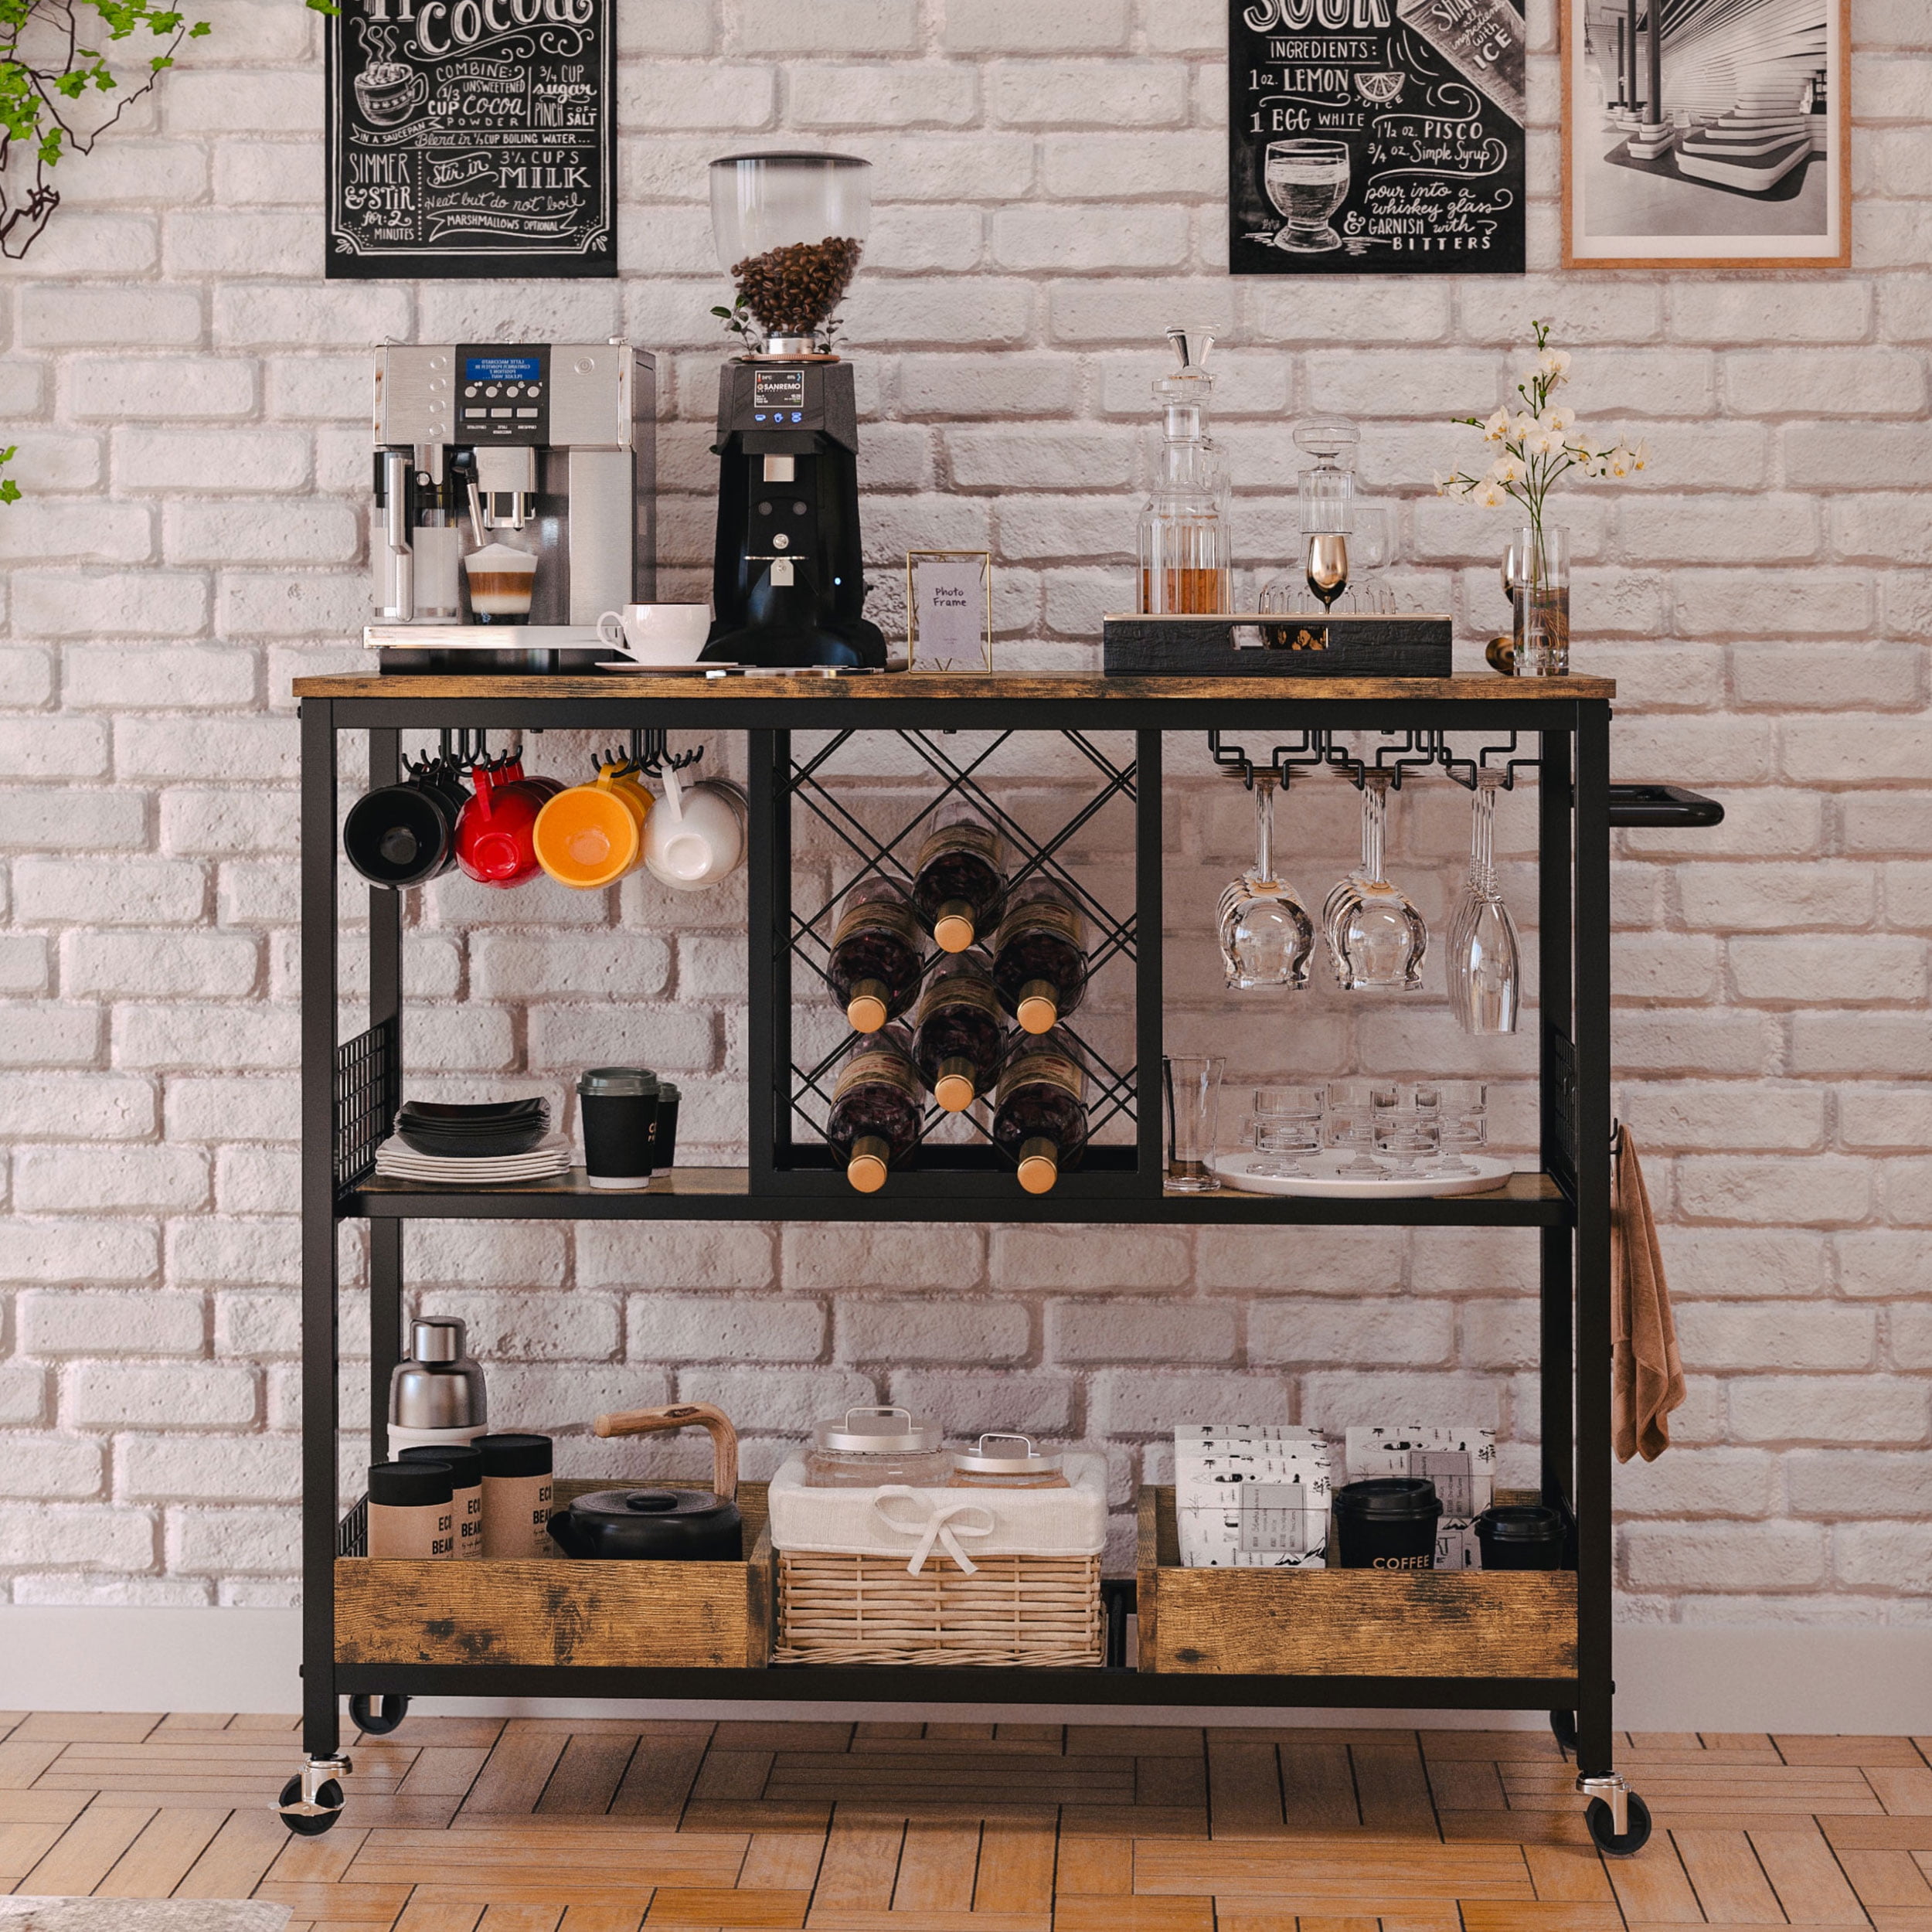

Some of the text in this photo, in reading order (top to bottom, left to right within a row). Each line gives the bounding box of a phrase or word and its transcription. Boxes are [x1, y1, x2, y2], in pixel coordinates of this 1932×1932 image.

[1472, 22, 1499, 46] with
[1270, 41, 1377, 59] INGREDIENTS:
[1473, 29, 1512, 70] ICE
[436, 62, 513, 82] COMBINE:
[561, 65, 584, 83] CUP
[1249, 69, 1260, 90] 1
[1283, 68, 1350, 93] LEMON
[463, 79, 526, 93] UNSWEETENED
[532, 83, 597, 104] sugar
[428, 94, 526, 115] CUP Cocoa
[1354, 94, 1403, 110] JUICE
[447, 117, 519, 127] POWDER
[535, 102, 563, 127] PINCH
[566, 113, 597, 126] SALT
[1250, 108, 1365, 133] 1 EGG WHITE
[360, 121, 426, 144] IN A SAUCEPAN
[415, 134, 456, 147] Blend
[457, 133, 471, 145] in
[484, 134, 500, 145] CUP
[503, 134, 539, 144] BOILING
[1424, 121, 1483, 140] PISCO
[531, 151, 579, 164] CUPS
[1409, 140, 1453, 165] Simple
[1454, 140, 1490, 169] Syrup
[349, 152, 410, 184] SIMMER
[433, 158, 490, 185] Stir in
[498, 166, 592, 189] MILK
[345, 185, 368, 209] &
[424, 192, 586, 212] Heat but do not boil
[1364, 182, 1477, 204] pour into a
[388, 210, 413, 226] 2
[1372, 198, 1493, 222] whiskey glass
[447, 214, 560, 231] MARSHMALLOWS OPTIONAL
[1343, 210, 1476, 235] & GARNISH with
[374, 228, 414, 241] MINUTES
[1392, 236, 1492, 251] BITTERS
[933, 597, 967, 607] Frame
[935, 587, 964, 597] Photo
[1372, 1555, 1429, 1570] COFFEE
